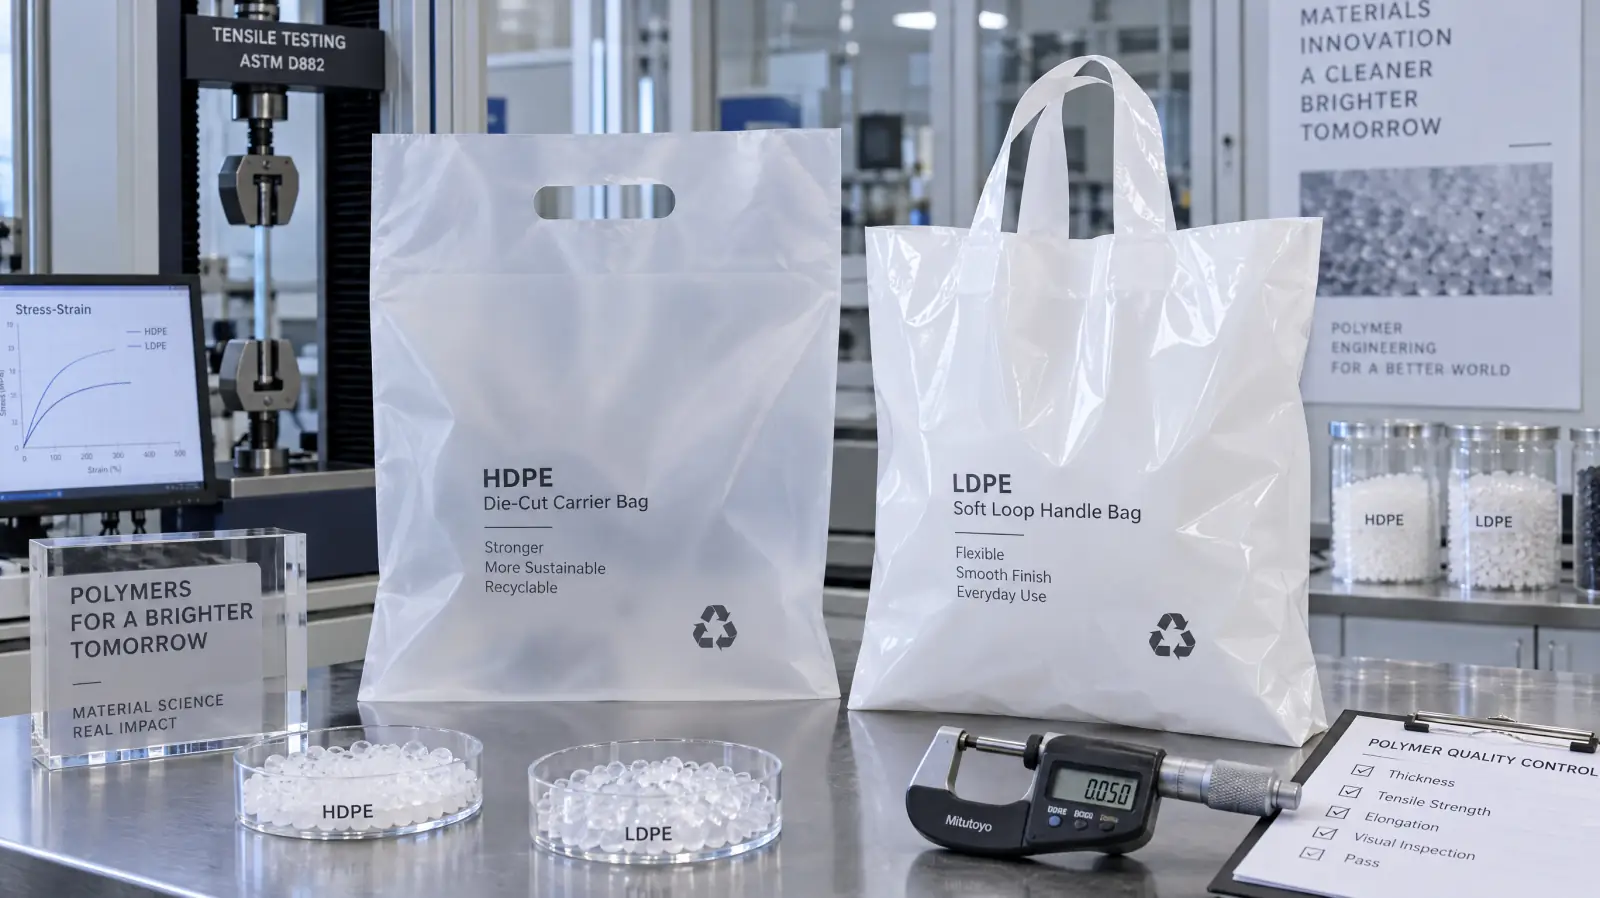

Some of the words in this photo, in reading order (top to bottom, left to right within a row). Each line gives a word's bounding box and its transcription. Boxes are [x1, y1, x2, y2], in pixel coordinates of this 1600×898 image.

[1301, 0, 1431, 26] MATERIALS
[212, 26, 277, 45] TENSILE
[281, 31, 346, 50] TESTING
[1300, 28, 1452, 55] INNOVATION
[239, 53, 283, 70] ASTM
[288, 56, 325, 72] D882
[1300, 67, 1315, 84] A
[1325, 60, 1433, 84] CLEANER
[1300, 89, 1418, 113] BRIGHTER
[1300, 117, 1442, 142] TOMORROW
[15, 303, 92, 316] Stress-Strain
[144, 327, 168, 336] HDPE
[1331, 322, 1403, 334] POLYMER
[145, 341, 167, 350] LDPE
[1331, 342, 1437, 355] ENGINEERING
[1331, 361, 1361, 375] FOR
[1368, 363, 1378, 375] A
[1386, 363, 1444, 376] BETTER
[1451, 364, 1511, 376] WORLD
[87, 466, 108, 474] Strain
[483, 467, 554, 488] HDPE
[952, 473, 1012, 494] LDPE
[484, 495, 549, 511] Die-Cut
[553, 494, 611, 510] Carrier
[616, 494, 649, 512] Bag
[953, 500, 987, 517] Soft
[992, 502, 1034, 521] Loop
[1040, 502, 1102, 519] Handle
[1108, 504, 1142, 524] Bag
[1365, 513, 1405, 526] HDPE
[1475, 515, 1513, 529] LDPE
[484, 540, 544, 556] Stronger
[956, 546, 1005, 561] Flexible
[485, 561, 521, 574] More
[525, 561, 606, 575] Sustainable
[956, 566, 1008, 581] Smooth
[1012, 569, 1052, 584] Finish
[70, 580, 192, 605] POLYMERS
[485, 580, 558, 596] Recyclable
[957, 586, 1016, 604] Everyday
[1020, 589, 1047, 603] Use
[70, 611, 116, 632] FOR
[123, 610, 138, 628] A
[145, 602, 253, 627] BRIGHTER
[70, 632, 208, 659] TOMORROW
[73, 700, 152, 720] MATERIAL
[158, 694, 224, 712] SCIENCE
[73, 722, 113, 739] REAL
[119, 717, 177, 735] IMPACT
[1368, 738, 1443, 756] POLYMER
[1447, 747, 1517, 765] QUALITY
[1521, 757, 1599, 777] CONTROL
[1388, 769, 1456, 788] Thickness
[1084, 778, 1132, 806] 0.050
[322, 803, 374, 820] HDPE
[1377, 790, 1426, 808] Tensile
[1429, 799, 1492, 819] Strength
[945, 814, 993, 833] Mitutoyo
[1364, 811, 1440, 833] Elongation
[624, 825, 673, 842] LDPE
[1354, 832, 1397, 849] Visual
[1399, 840, 1476, 862] Inspection
[1343, 853, 1381, 869] Pass
